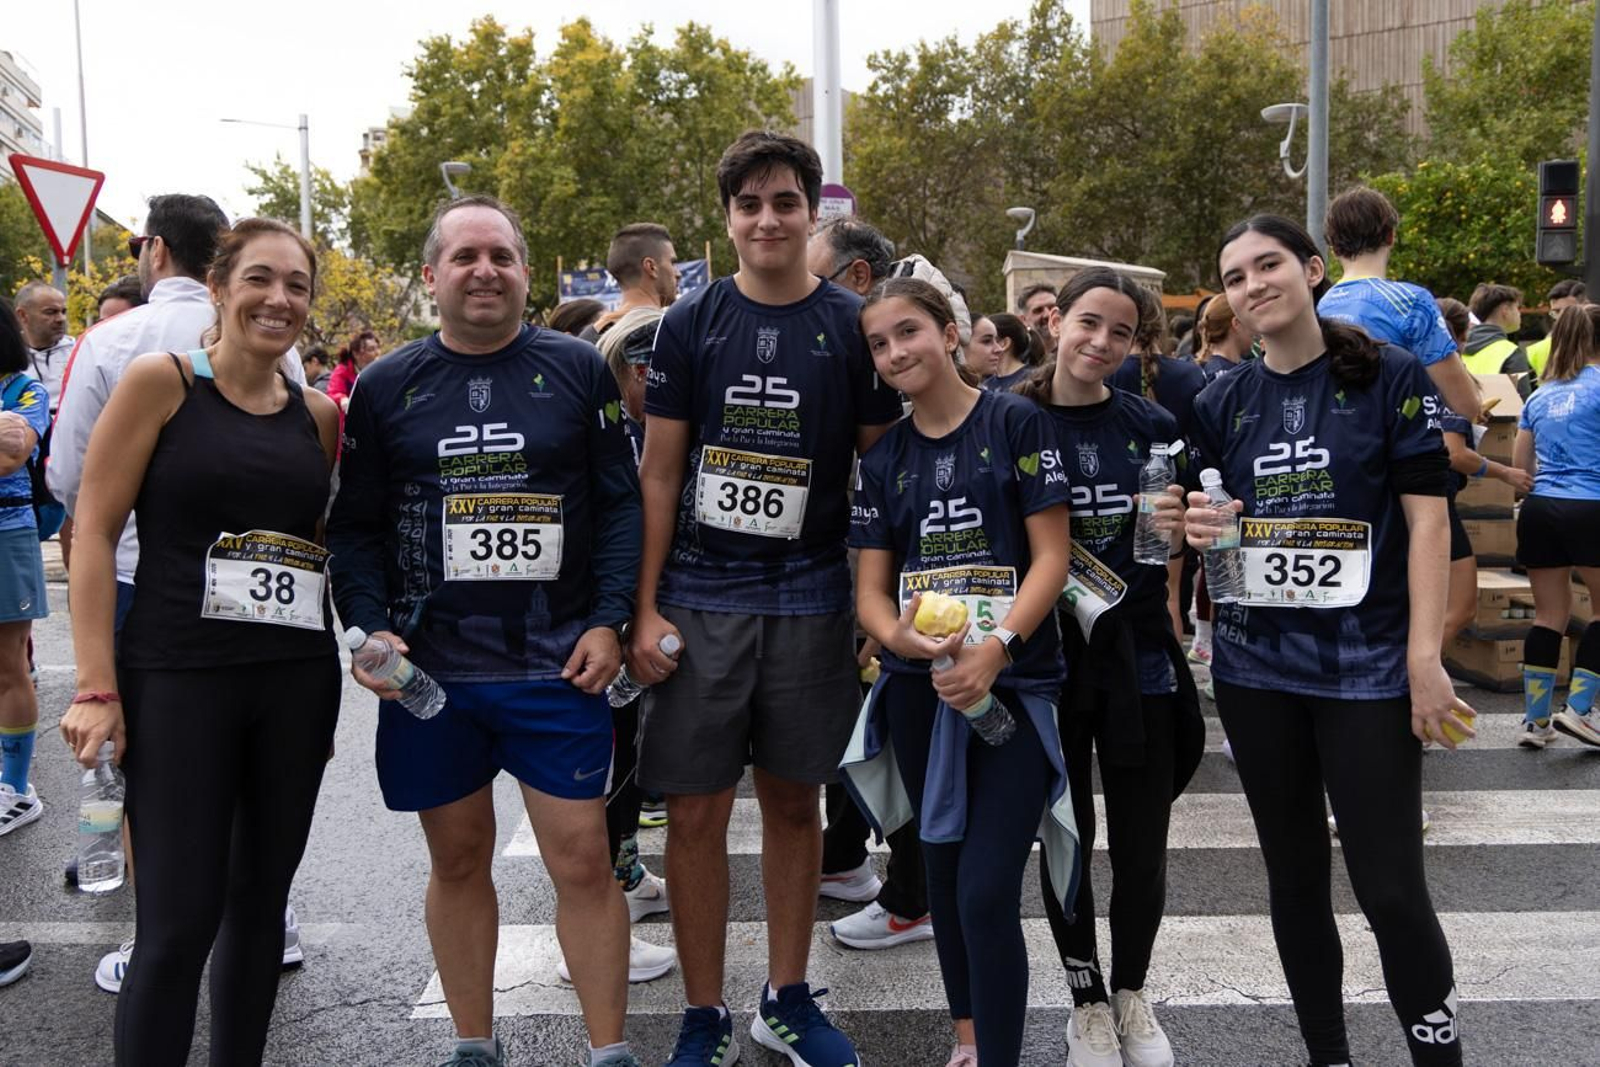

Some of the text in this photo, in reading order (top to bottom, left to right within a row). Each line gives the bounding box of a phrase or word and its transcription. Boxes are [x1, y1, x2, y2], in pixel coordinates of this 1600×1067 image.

[724, 374, 800, 409] 25
[723, 405, 798, 420] CARRERA
[723, 415, 800, 431] POPULAR
[437, 422, 525, 458] 25
[756, 429, 800, 438] caminata
[438, 452, 525, 468] CARRERA
[708, 450, 730, 466] XXV
[731, 454, 768, 465] CARRERA
[769, 459, 806, 470] POPULAR
[1253, 435, 1330, 477] 25
[441, 463, 528, 477] POPULAR
[478, 473, 528, 482] caminata
[741, 463, 762, 471] gran
[766, 466, 806, 476] caminata
[1255, 469, 1331, 488] CARRERA
[1256, 480, 1333, 499] POPULAR
[1265, 496, 1289, 505] gran
[1291, 492, 1335, 502] caminata
[449, 499, 475, 513] XXV
[519, 505, 558, 513] caminata
[717, 482, 785, 518] 386
[1071, 484, 1133, 517] 25
[920, 496, 983, 537] 25
[1245, 523, 1273, 538] XXV
[1319, 524, 1364, 532] POPULAR
[1274, 531, 1280, 539] y
[1316, 531, 1364, 539] caminata
[257, 544, 281, 553] gran
[285, 548, 324, 561] caminata
[469, 529, 542, 561] 385
[1264, 553, 1342, 587] 352
[249, 567, 295, 605] 38
[906, 571, 1010, 590] XXV CARRERA POPULAR
[943, 579, 966, 587] gran
[972, 577, 1010, 585] caminata
[1085, 568, 1119, 597] caminata
[1411, 1017, 1457, 1044] ad
